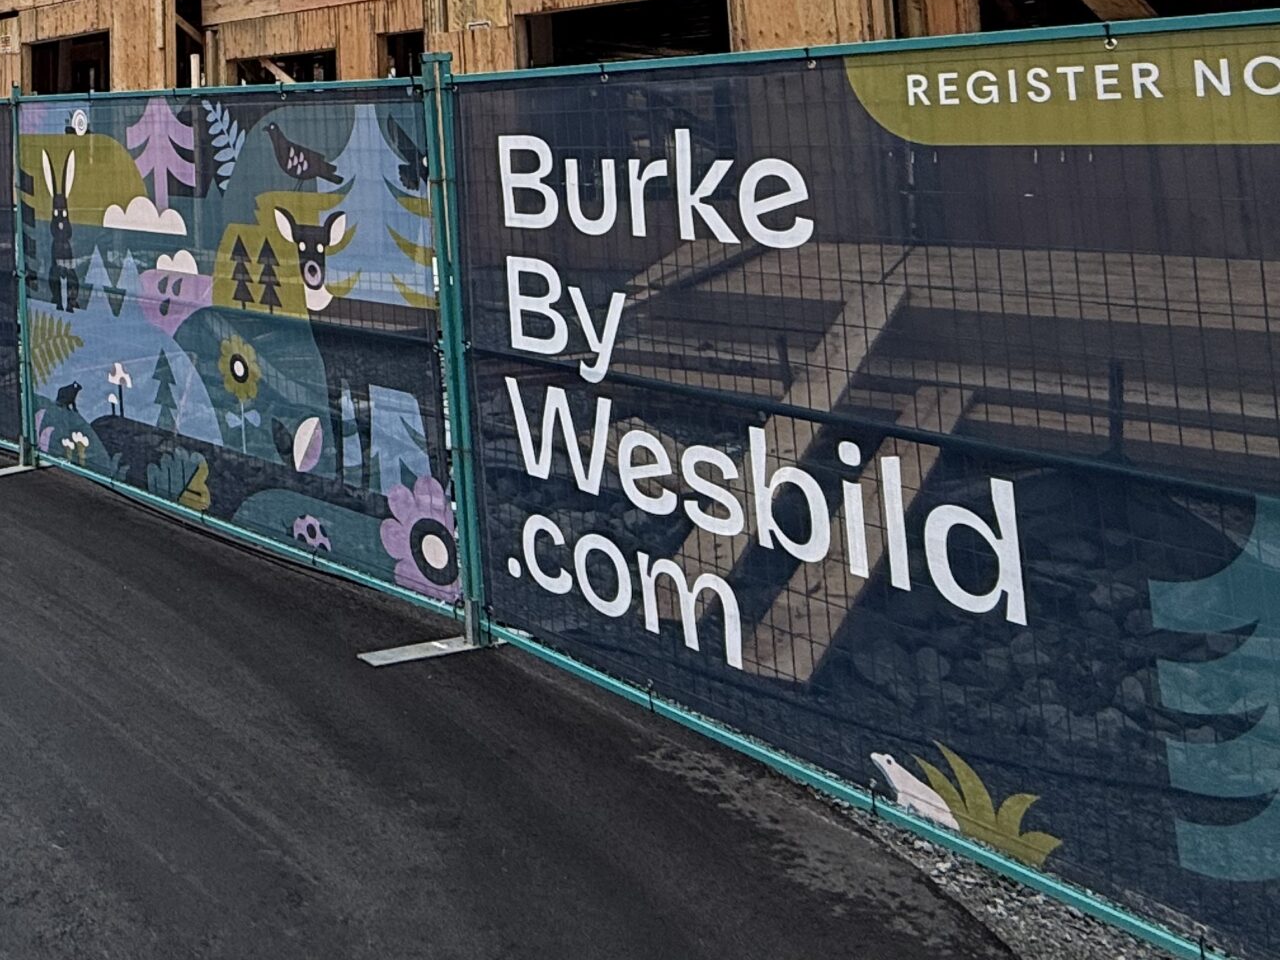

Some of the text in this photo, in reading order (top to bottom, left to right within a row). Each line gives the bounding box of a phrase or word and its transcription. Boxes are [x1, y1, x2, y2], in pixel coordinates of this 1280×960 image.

[906, 61, 1164, 106] REGISTER
[498, 128, 814, 249] Burke
[506, 255, 626, 383] By
[505, 376, 1027, 626] Wesbild
[508, 514, 743, 670] .com
